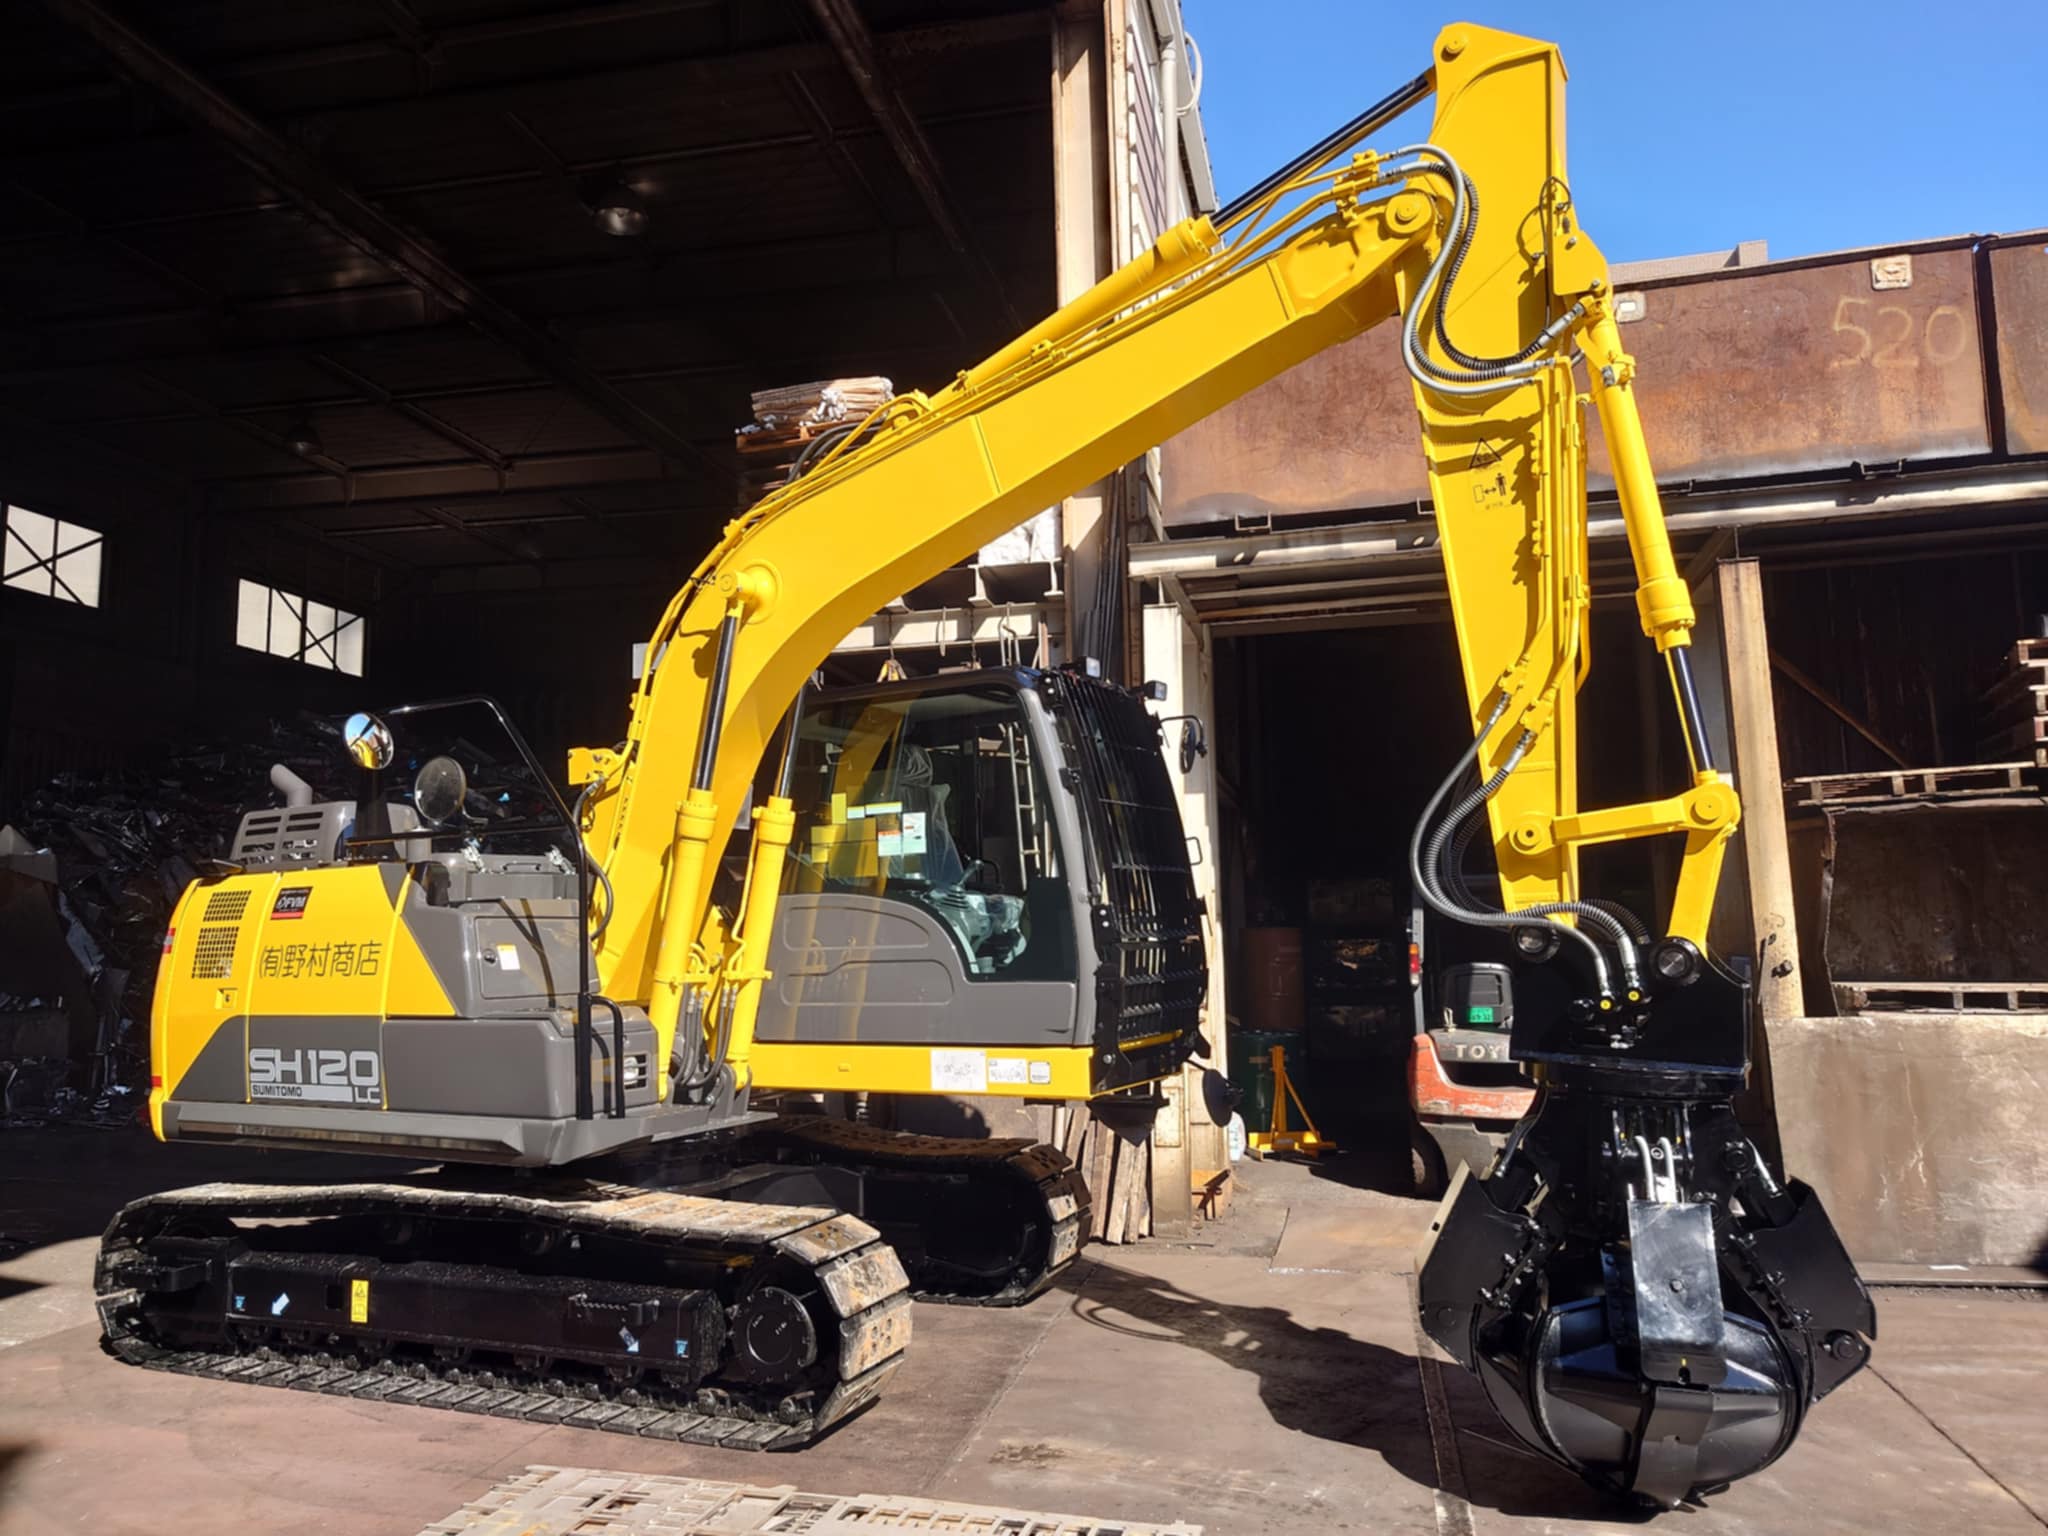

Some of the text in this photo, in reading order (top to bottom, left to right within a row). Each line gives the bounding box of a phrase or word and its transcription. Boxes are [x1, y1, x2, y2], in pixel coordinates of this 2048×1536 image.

[1830, 295, 1967, 368] 520
[1455, 1044, 1502, 1059] TOY
[249, 1047, 380, 1087] SH120
[252, 1083, 303, 1098] SUMITOMO
[354, 1085, 381, 1104] LC
